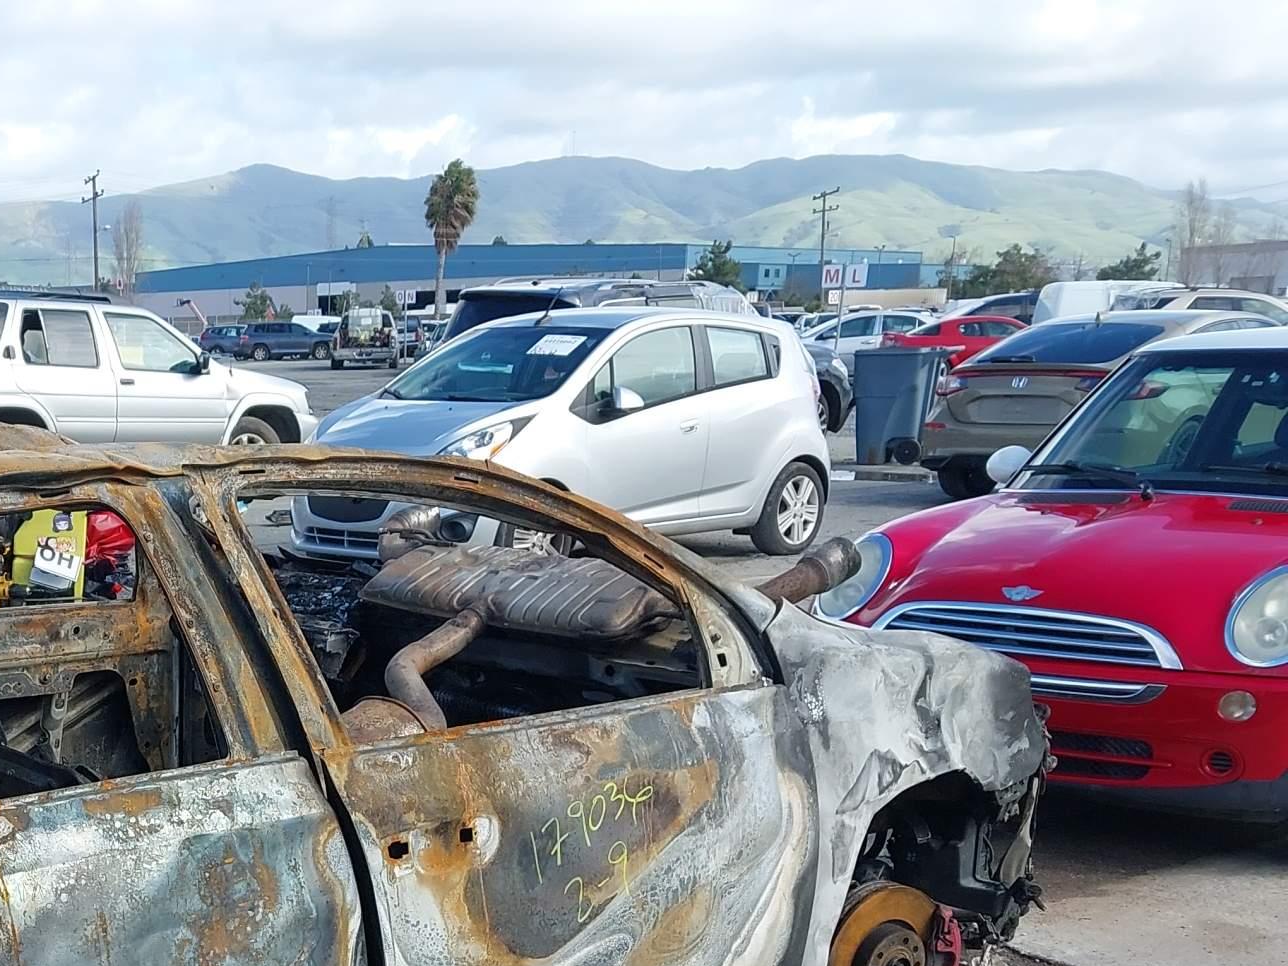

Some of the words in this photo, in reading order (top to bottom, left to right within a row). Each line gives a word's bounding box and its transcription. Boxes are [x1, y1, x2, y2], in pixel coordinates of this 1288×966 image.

[824, 268, 840, 284] M
[852, 268, 861, 283] L
[563, 841, 631, 923] 2-9
